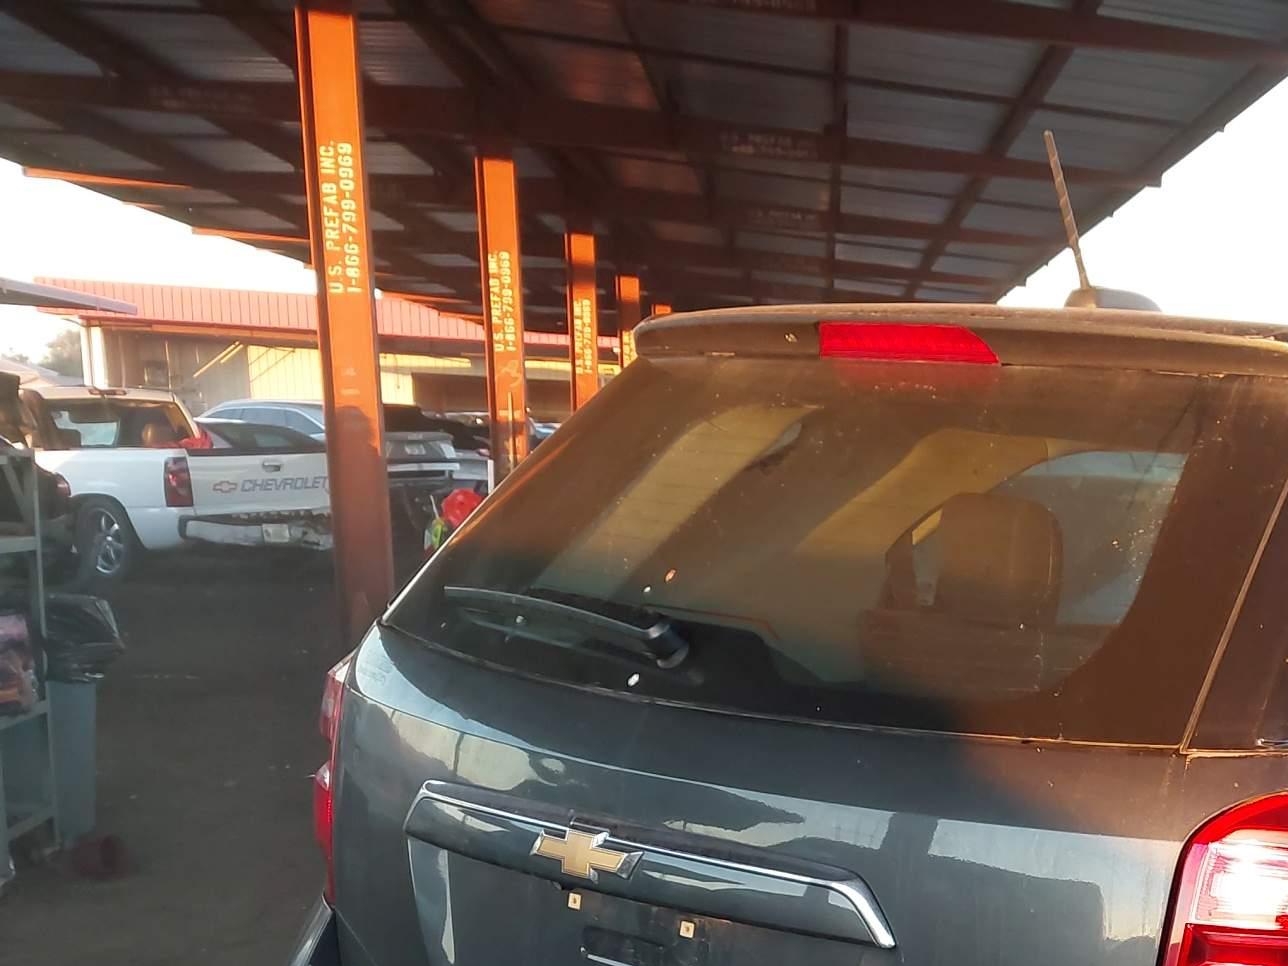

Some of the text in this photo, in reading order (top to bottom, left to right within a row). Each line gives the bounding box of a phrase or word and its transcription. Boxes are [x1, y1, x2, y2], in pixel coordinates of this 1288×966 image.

[319, 140, 345, 295] U.S. PREFAB INC.
[337, 142, 362, 293] 1-866-799-0969
[241, 475, 328, 493] CHEVROLET
